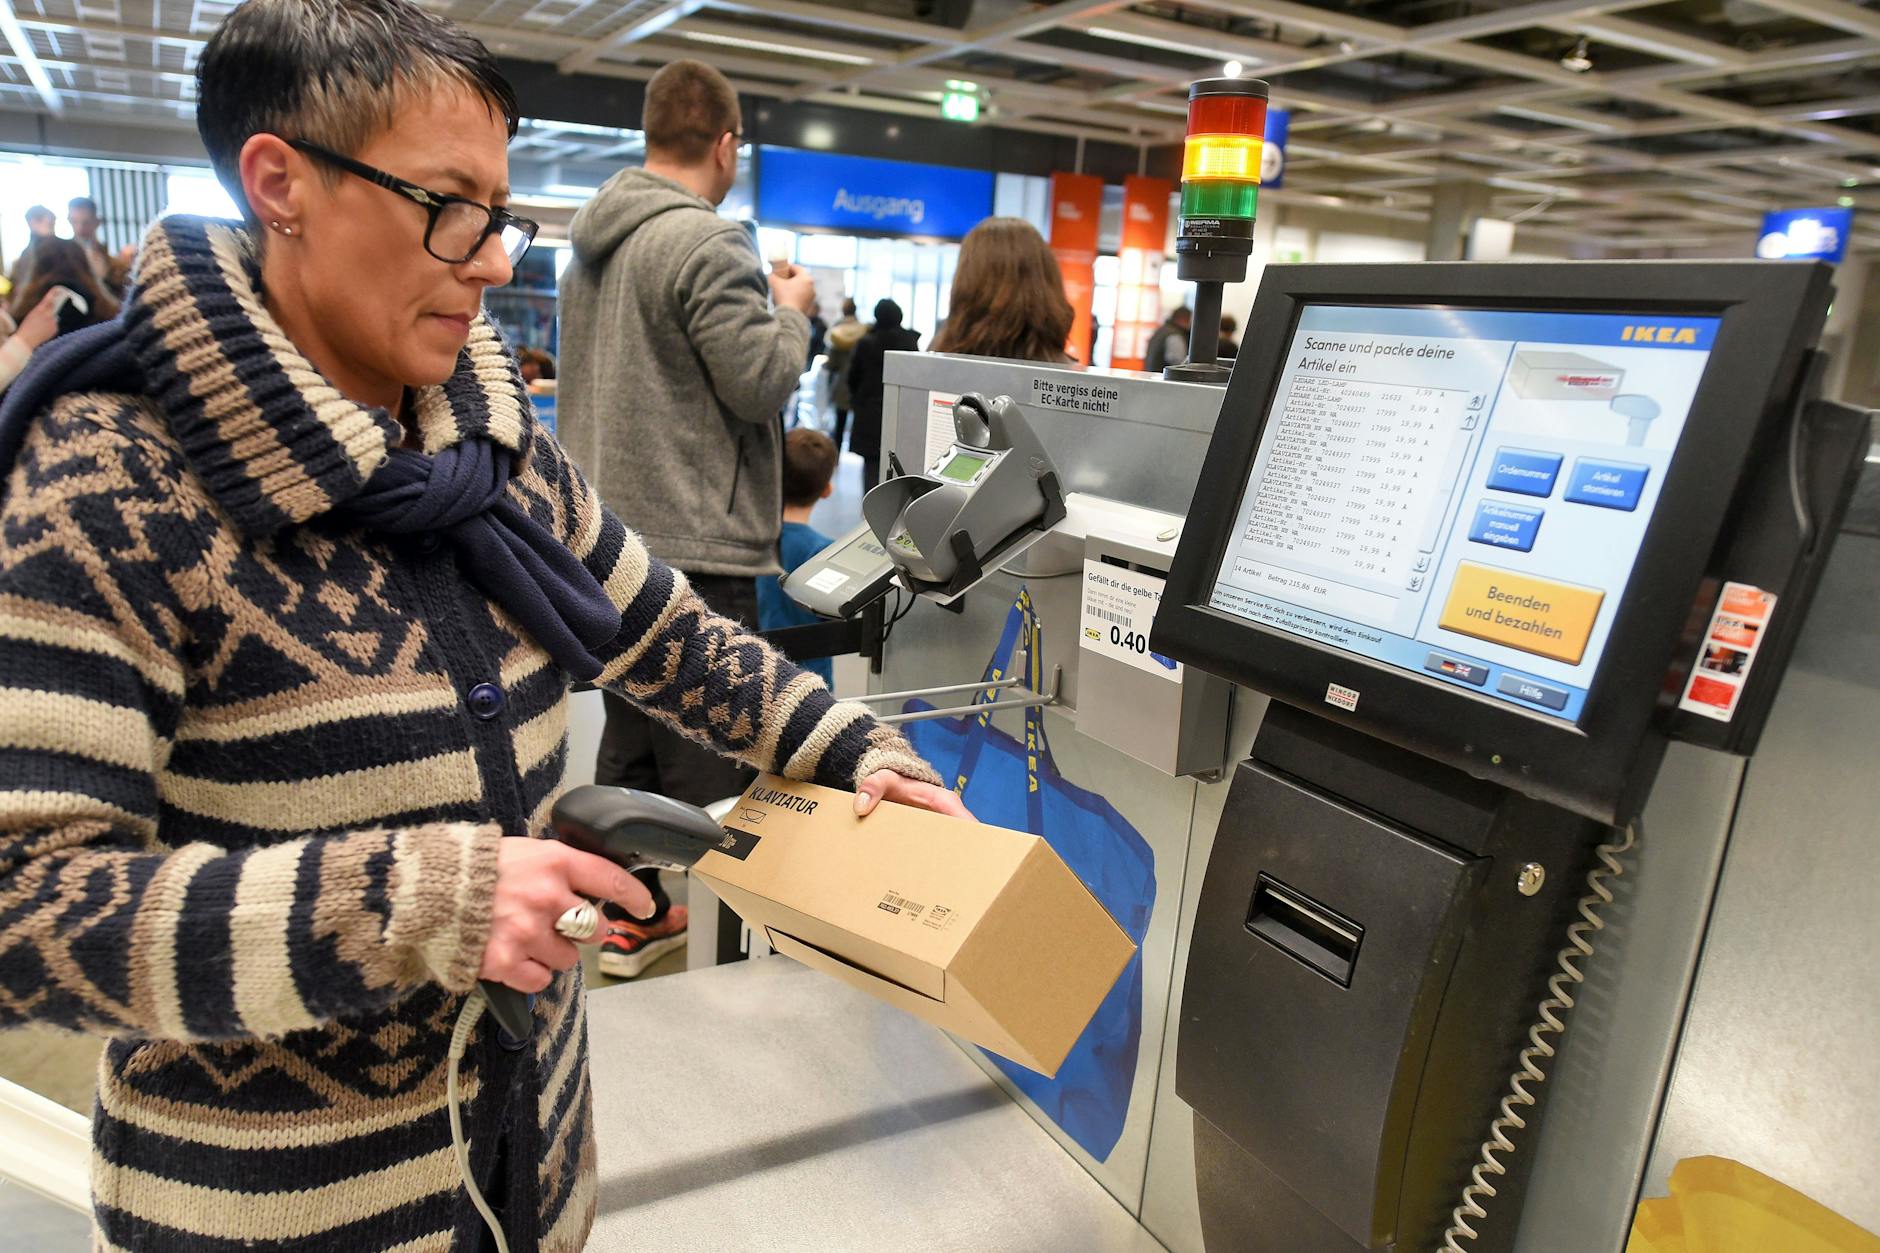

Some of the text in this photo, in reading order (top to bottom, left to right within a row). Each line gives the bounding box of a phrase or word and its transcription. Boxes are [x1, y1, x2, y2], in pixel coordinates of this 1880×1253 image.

[833, 188, 925, 224] Ausgang
[1620, 326, 1697, 343] IKEA
[1304, 337, 1455, 360] Scanne und packe deine
[1298, 357, 1357, 374] Artikel ein
[1034, 379, 1118, 400] Bitte vergiss deine
[1041, 393, 1109, 413] EC-Karte nicht!
[1110, 579, 1119, 589] dir
[1121, 582, 1131, 593] die
[1133, 586, 1153, 599] gelbe
[1243, 567, 1262, 577] Artikel
[1268, 574, 1288, 585] Betrag
[1313, 586, 1327, 595] EUR
[1487, 585, 1551, 614] Beenden
[1223, 592, 1243, 602] unseren
[1245, 597, 1263, 608] Service
[1274, 607, 1285, 615] dich
[1329, 624, 1343, 632] wird
[1343, 628, 1357, 637] dein
[1358, 632, 1382, 643] Einkauf
[1275, 616, 1314, 634] Zufallsprinzip
[1465, 606, 1563, 640] und bezahlen
[1087, 630, 1099, 638] IKEA
[1110, 625, 1146, 654] 0.40
[1328, 695, 1354, 707] NIXDORF
[1330, 685, 1356, 699] WINCOR
[1519, 684, 1544, 700] Hilfe
[1027, 721, 1038, 792] IKEA
[748, 786, 819, 815] KLAVIATUR
